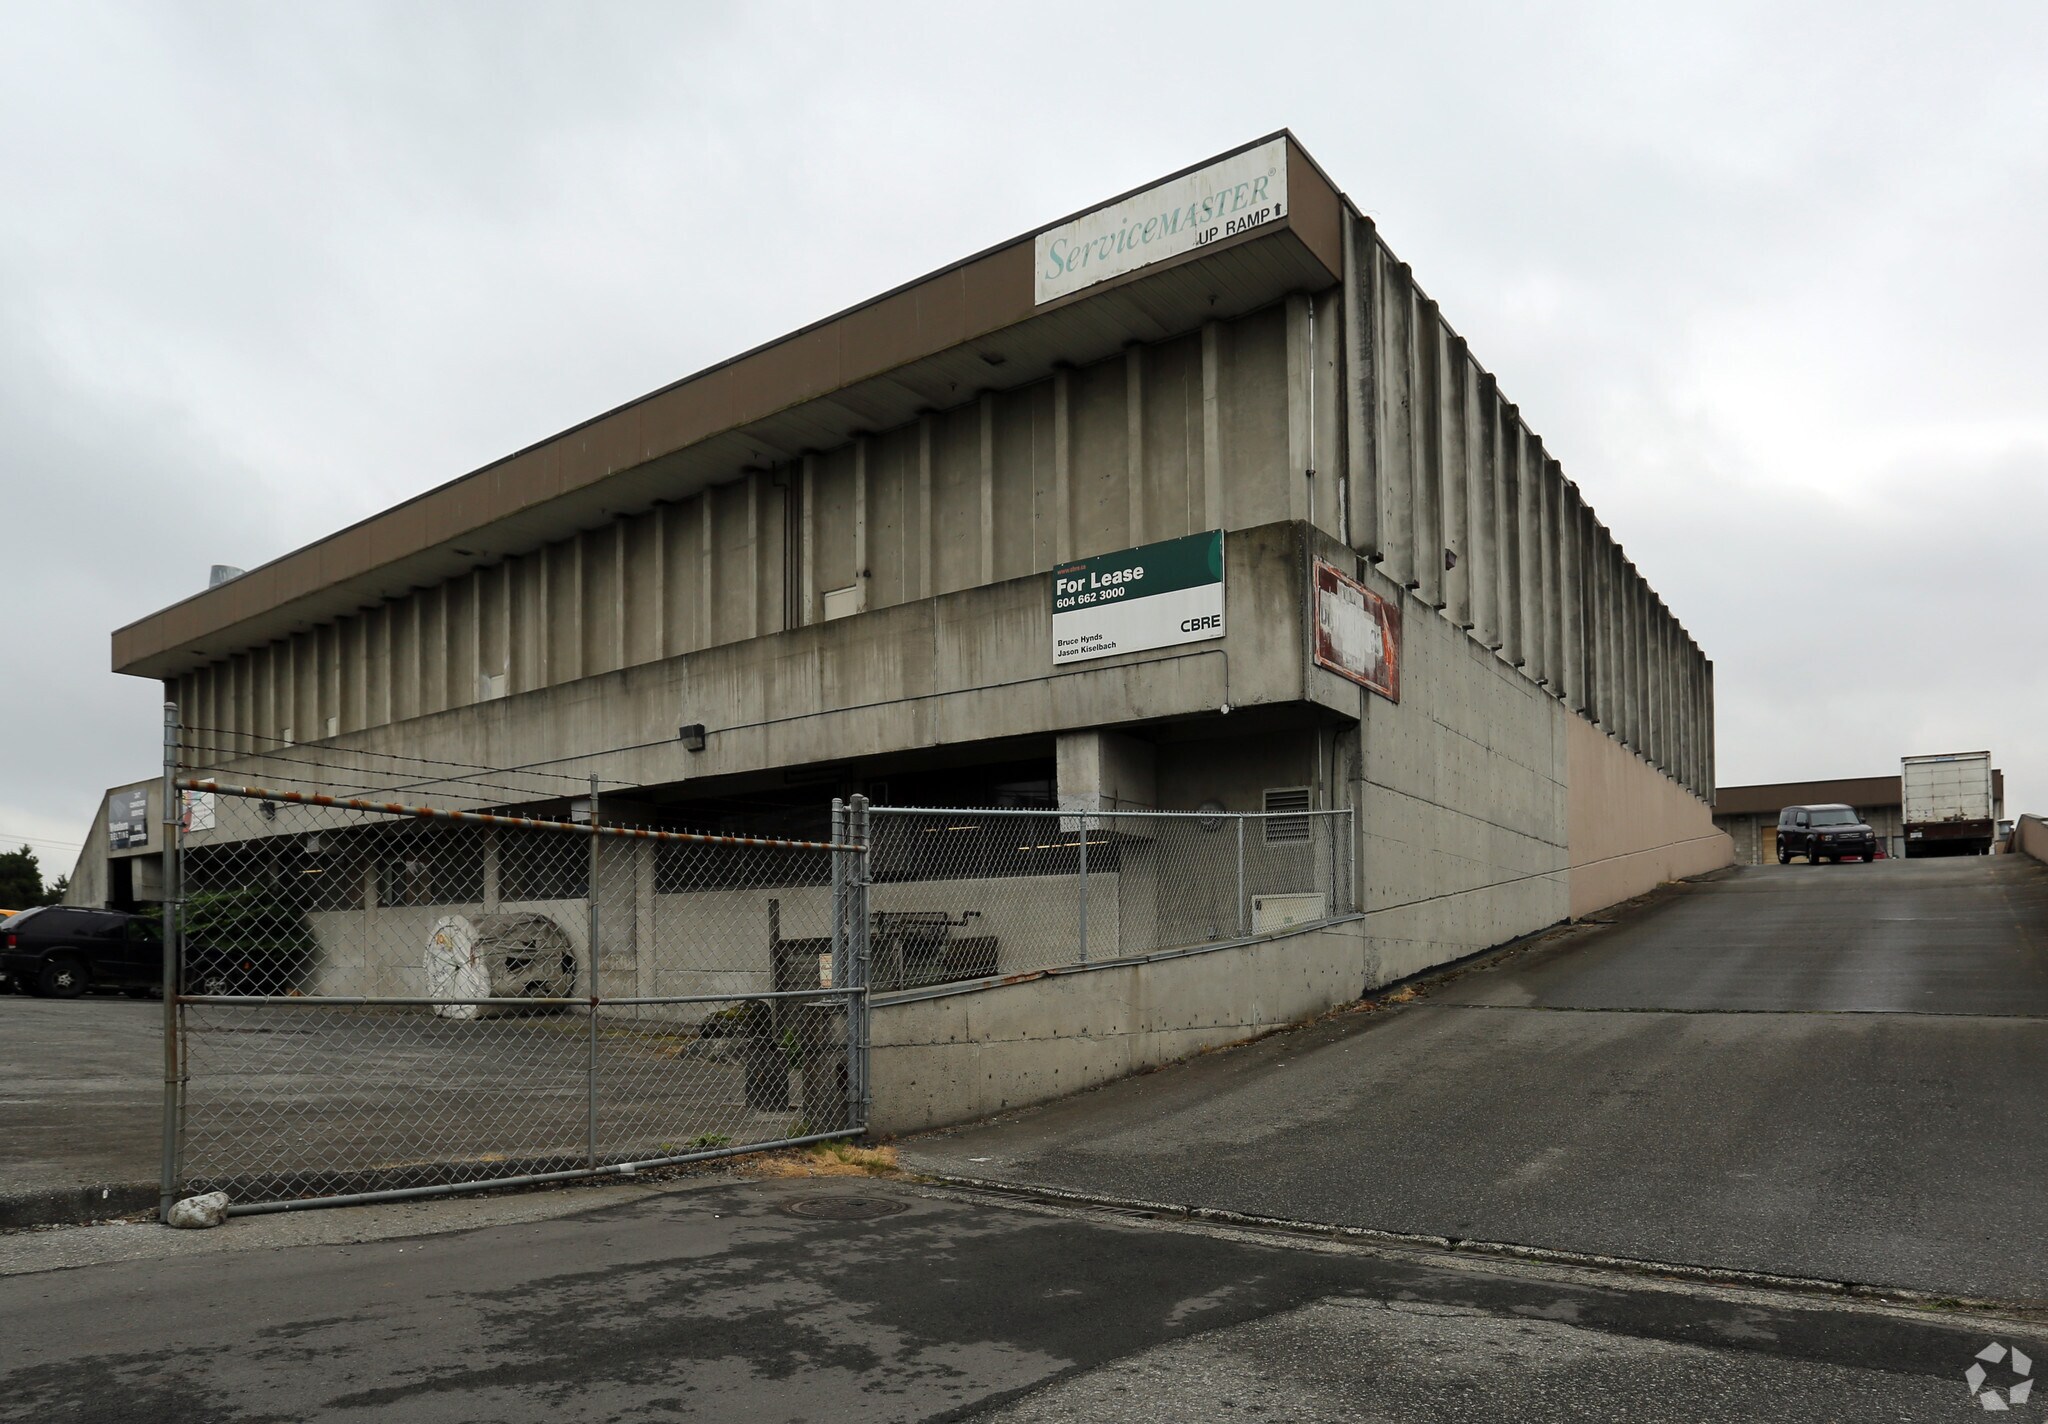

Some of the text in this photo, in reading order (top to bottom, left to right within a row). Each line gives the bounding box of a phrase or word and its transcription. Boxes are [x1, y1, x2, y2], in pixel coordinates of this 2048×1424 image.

[1198, 208, 1271, 245] UP RAMP
[1056, 566, 1144, 596] For Lease
[1056, 586, 1126, 608] 604 662 3000
[1180, 614, 1221, 633] CBRE
[1057, 633, 1103, 647] Bruce Hynds
[1057, 641, 1117, 657] Jason Kiselbach
